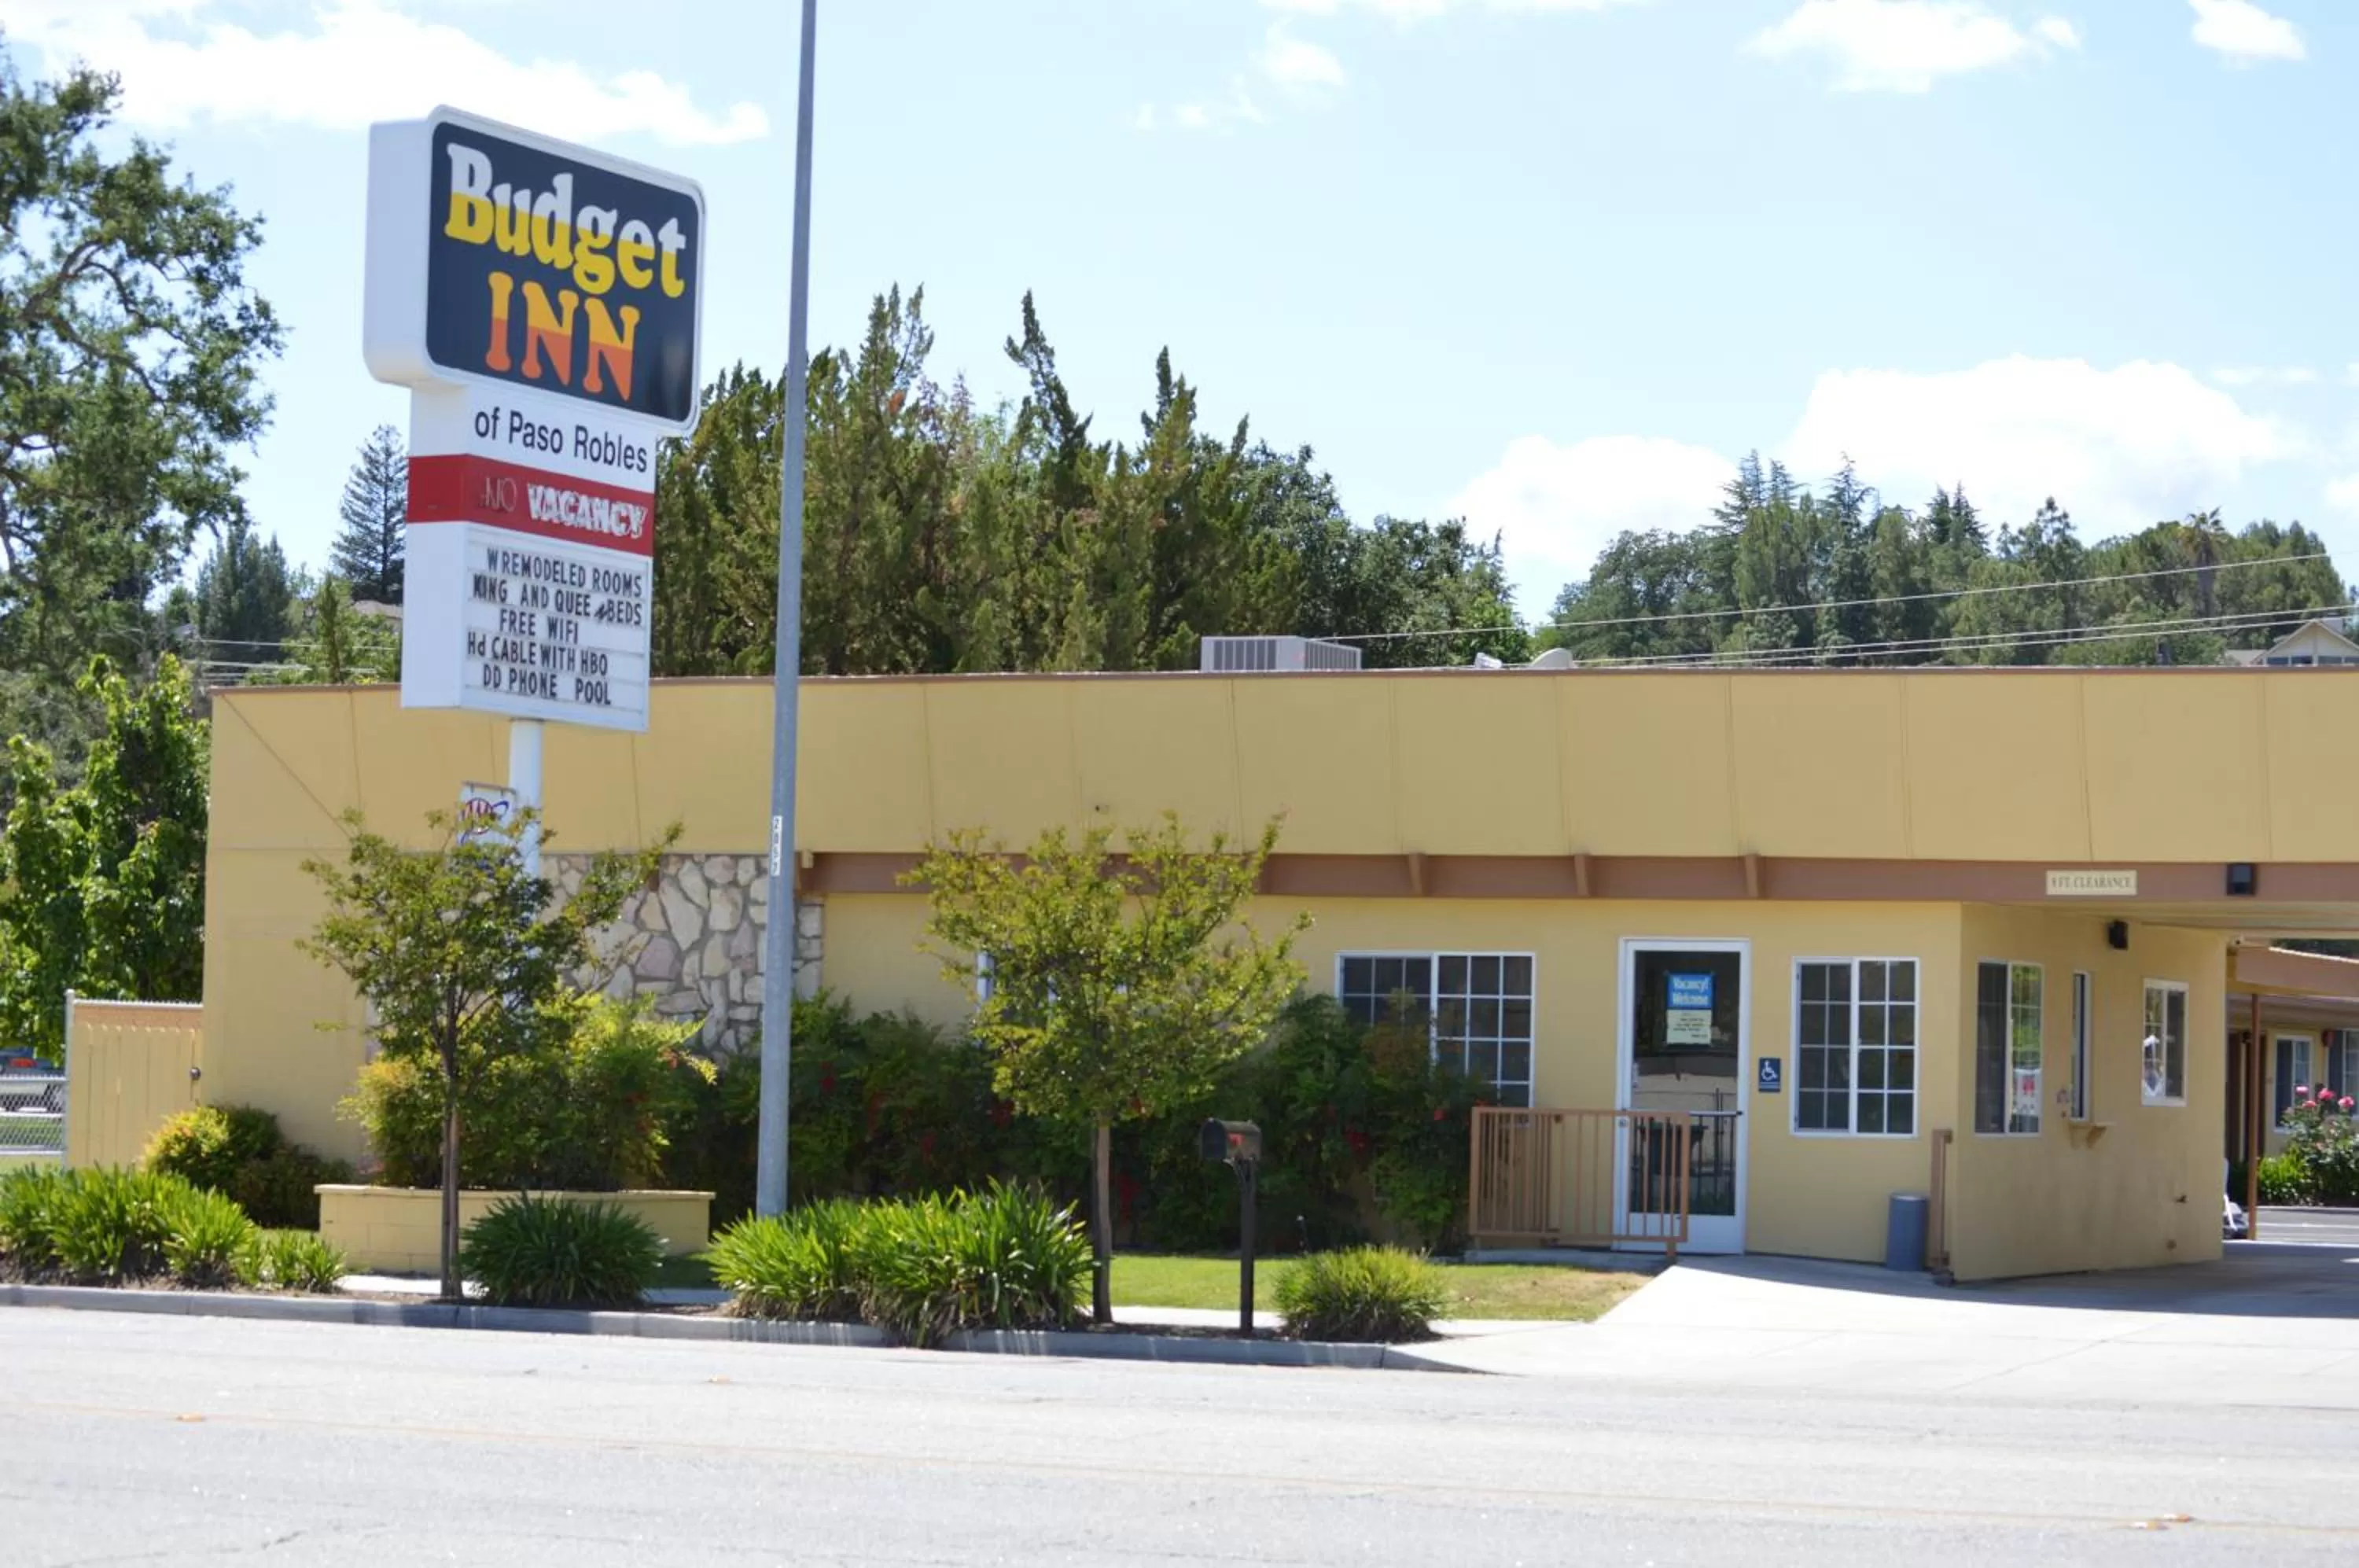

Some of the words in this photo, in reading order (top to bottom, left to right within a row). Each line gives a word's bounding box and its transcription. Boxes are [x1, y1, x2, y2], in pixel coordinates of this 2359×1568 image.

[444, 142, 686, 298] Budget
[485, 271, 641, 402] INN
[474, 407, 501, 440] of
[509, 410, 564, 454] Paso
[574, 425, 647, 473] Robles
[528, 483, 649, 539] VACANCY
[473, 573, 508, 603] KING
[520, 583, 550, 609] AND
[607, 600, 642, 626] BEDS
[502, 552, 586, 588] REMODELED
[592, 567, 642, 598] ROOMS
[499, 609, 536, 637] FREE
[547, 615, 579, 645] WIFI
[491, 636, 536, 665] CABLE
[540, 643, 576, 672] WITH
[580, 650, 609, 677] HBO
[483, 664, 502, 690] DD
[509, 668, 558, 698] PHONE
[575, 680, 612, 705] POOL
[2074, 877, 2131, 888] CLEARANCE
